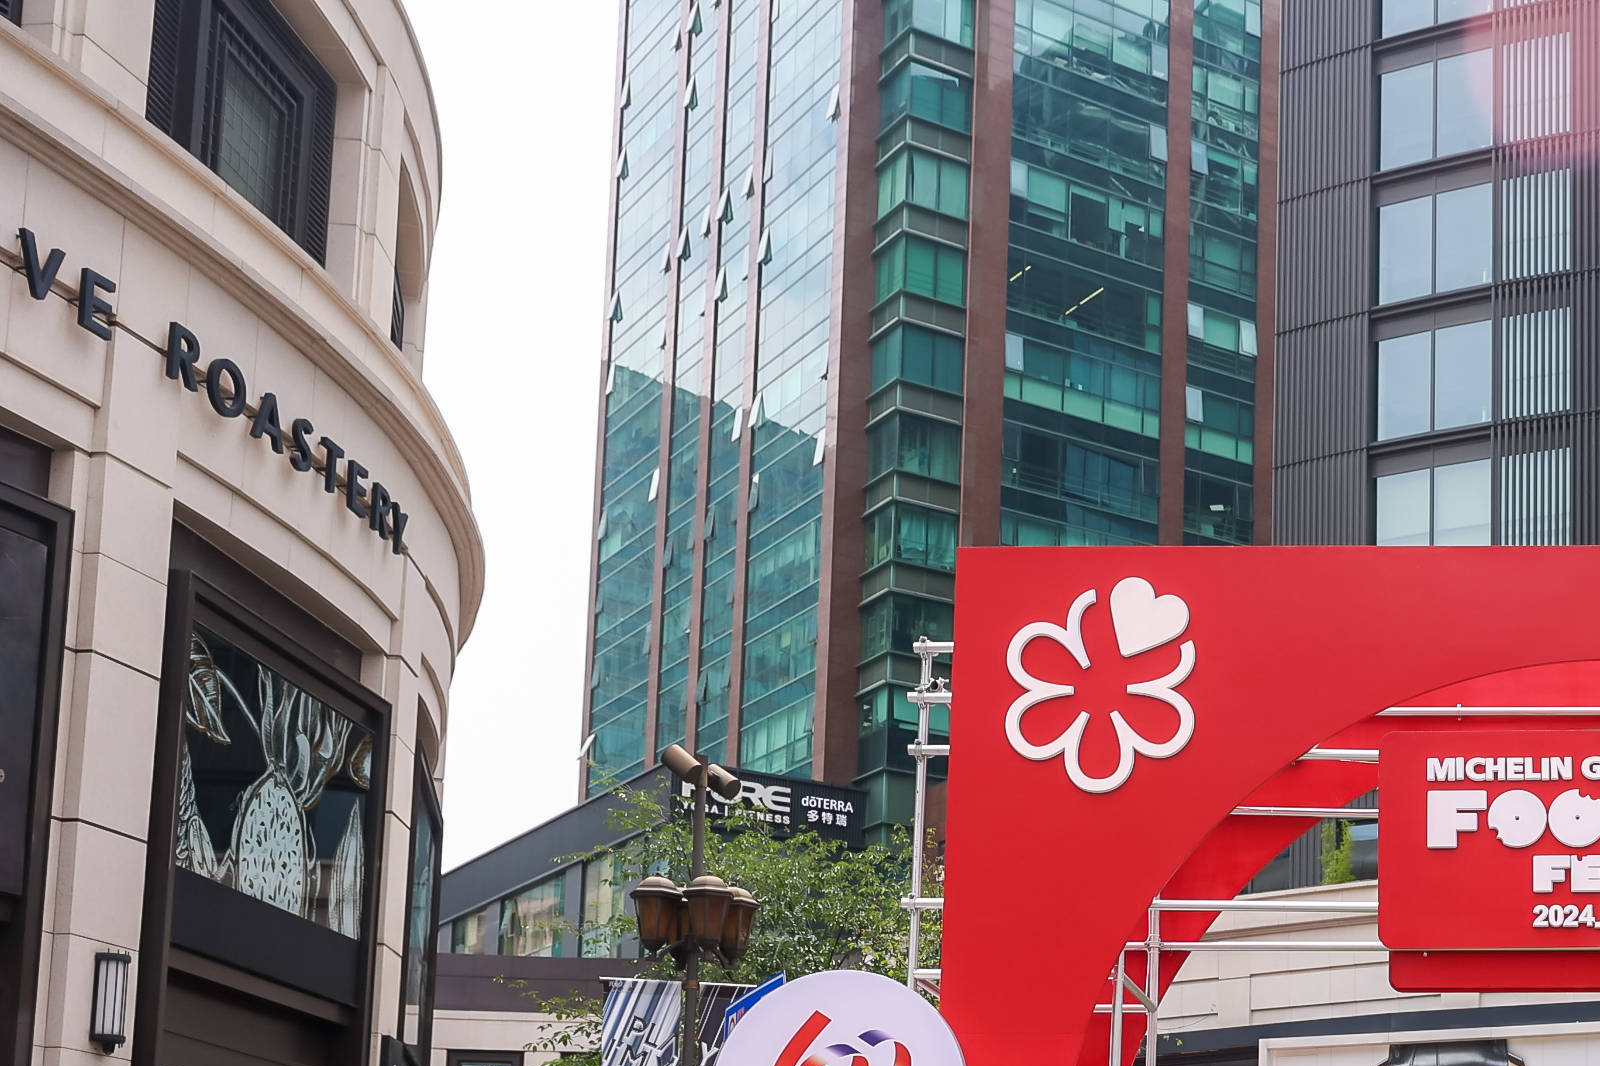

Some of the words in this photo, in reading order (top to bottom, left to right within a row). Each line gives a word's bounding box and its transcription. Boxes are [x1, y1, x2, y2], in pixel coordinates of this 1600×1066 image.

[166, 321, 409, 554] ROASTERY
[1426, 756, 1573, 782] MICHELIN
[807, 810, 848, 828] 多特瑞
